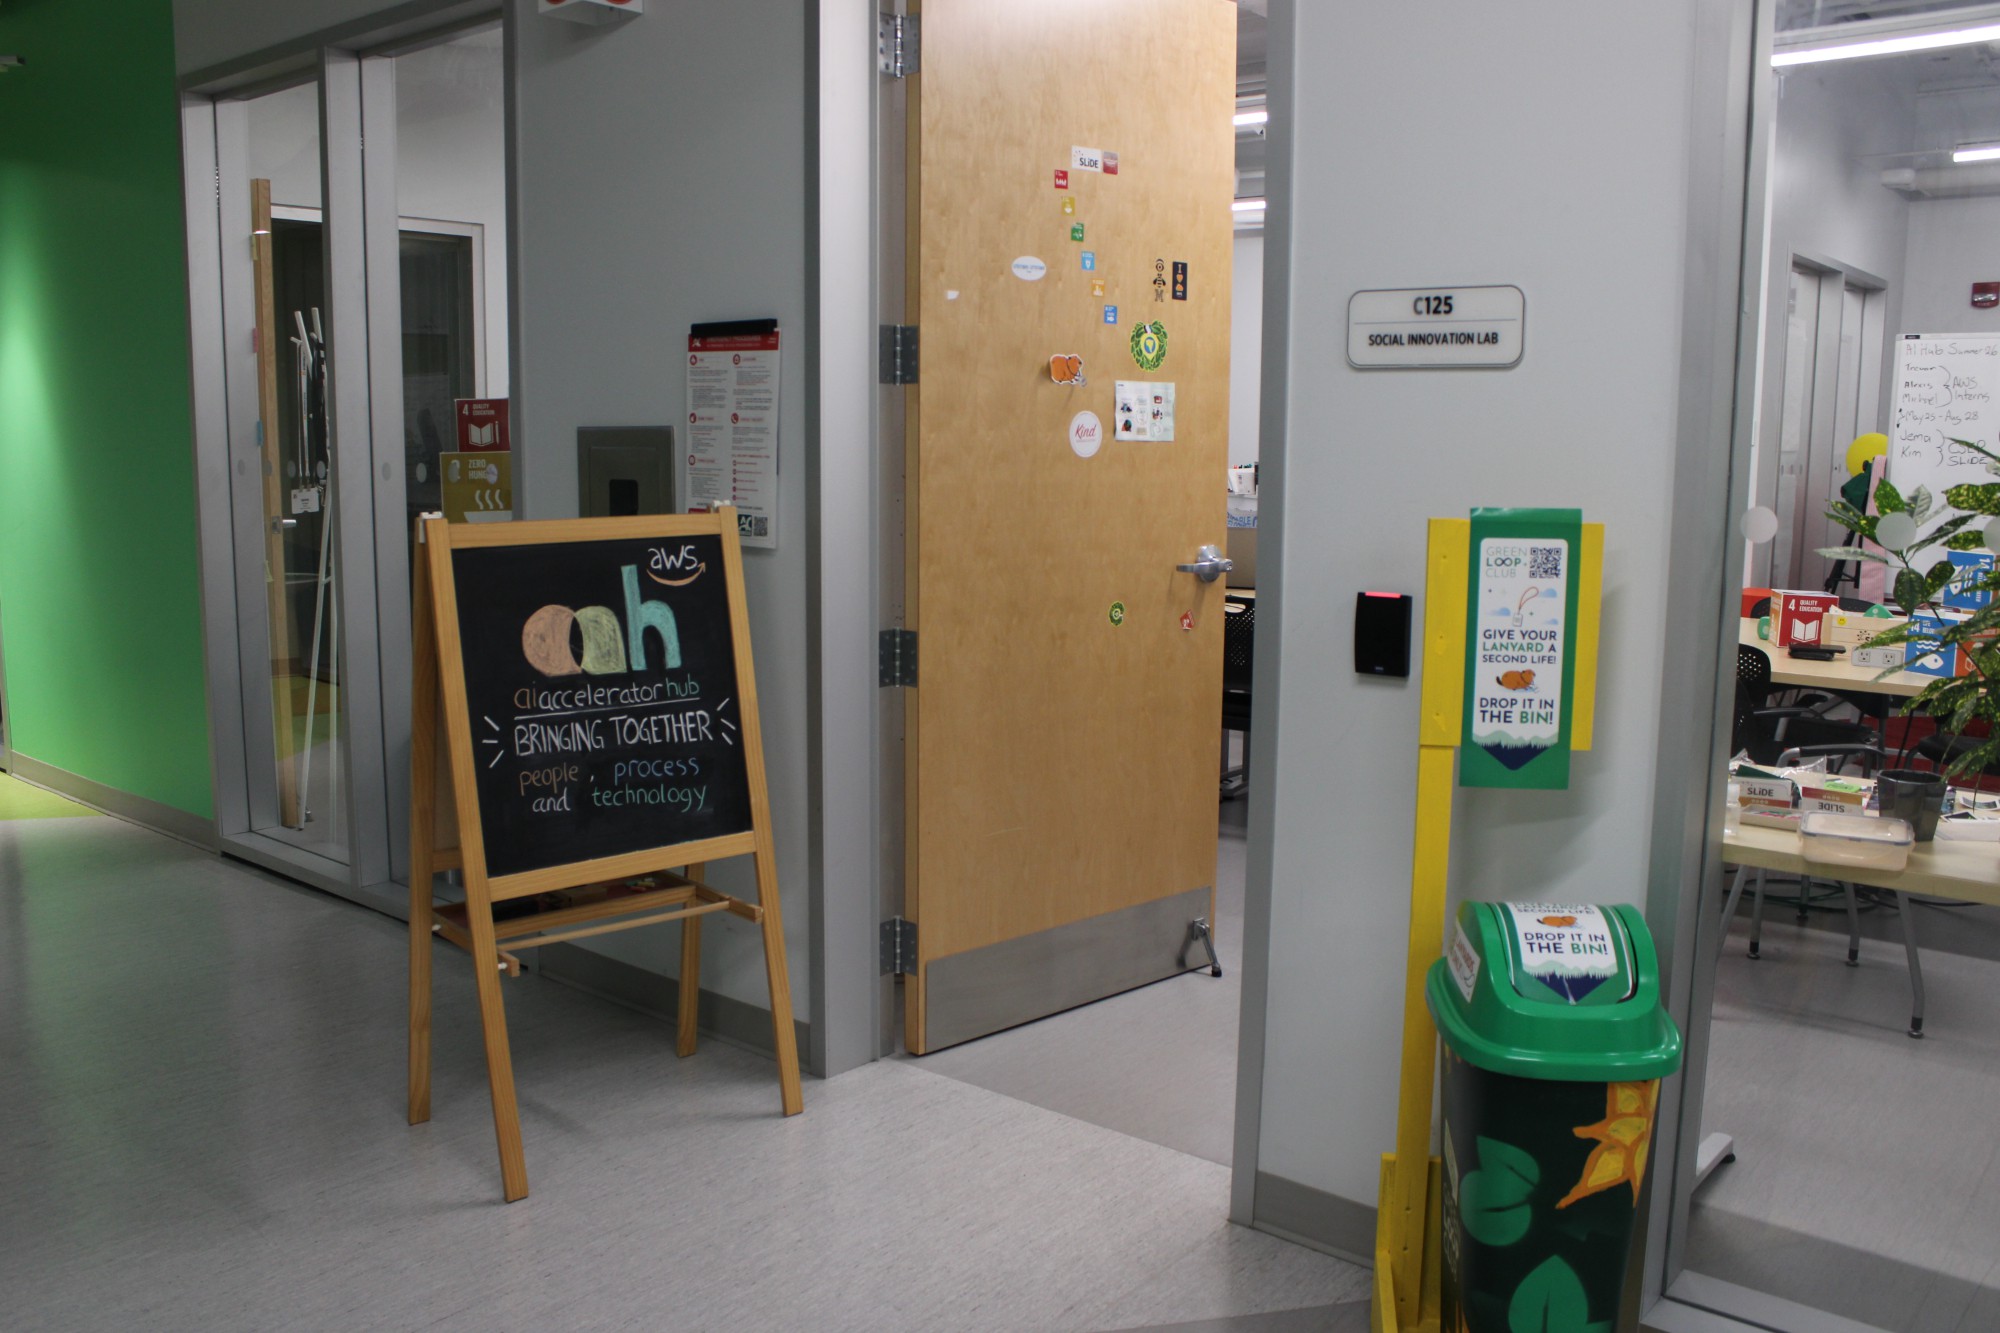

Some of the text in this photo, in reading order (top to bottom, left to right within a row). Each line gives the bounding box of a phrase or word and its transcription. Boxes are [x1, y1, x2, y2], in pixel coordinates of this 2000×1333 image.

[1413, 295, 1454, 316] C125
[1368, 331, 1499, 347] SOCIAL INNOVATION LAB
[1920, 343, 1944, 356] Hub
[1952, 376, 1978, 389] AWS
[462, 403, 469, 416] 4
[1074, 423, 1097, 440] Kind
[1900, 446, 1922, 458] Kim
[468, 459, 486, 469] ZERO
[648, 545, 698, 571] aws
[1486, 546, 1528, 557] GREEN
[1485, 567, 1517, 578] CLUB
[1788, 598, 1796, 611] 4
[1483, 629, 1557, 641] GIVE YOUR
[1482, 641, 1557, 653] LANYARD A
[1482, 654, 1557, 665] SECOND LIFE!
[1480, 697, 1554, 710] DROP IT IN
[1480, 710, 1553, 725] THE BIN!
[514, 710, 713, 757] BRINGING TOGETHER
[614, 757, 700, 786] process
[532, 783, 707, 813] and technology
[1524, 932, 1605, 942] DROP IT IN
[1526, 942, 1608, 955] THE BIN!
